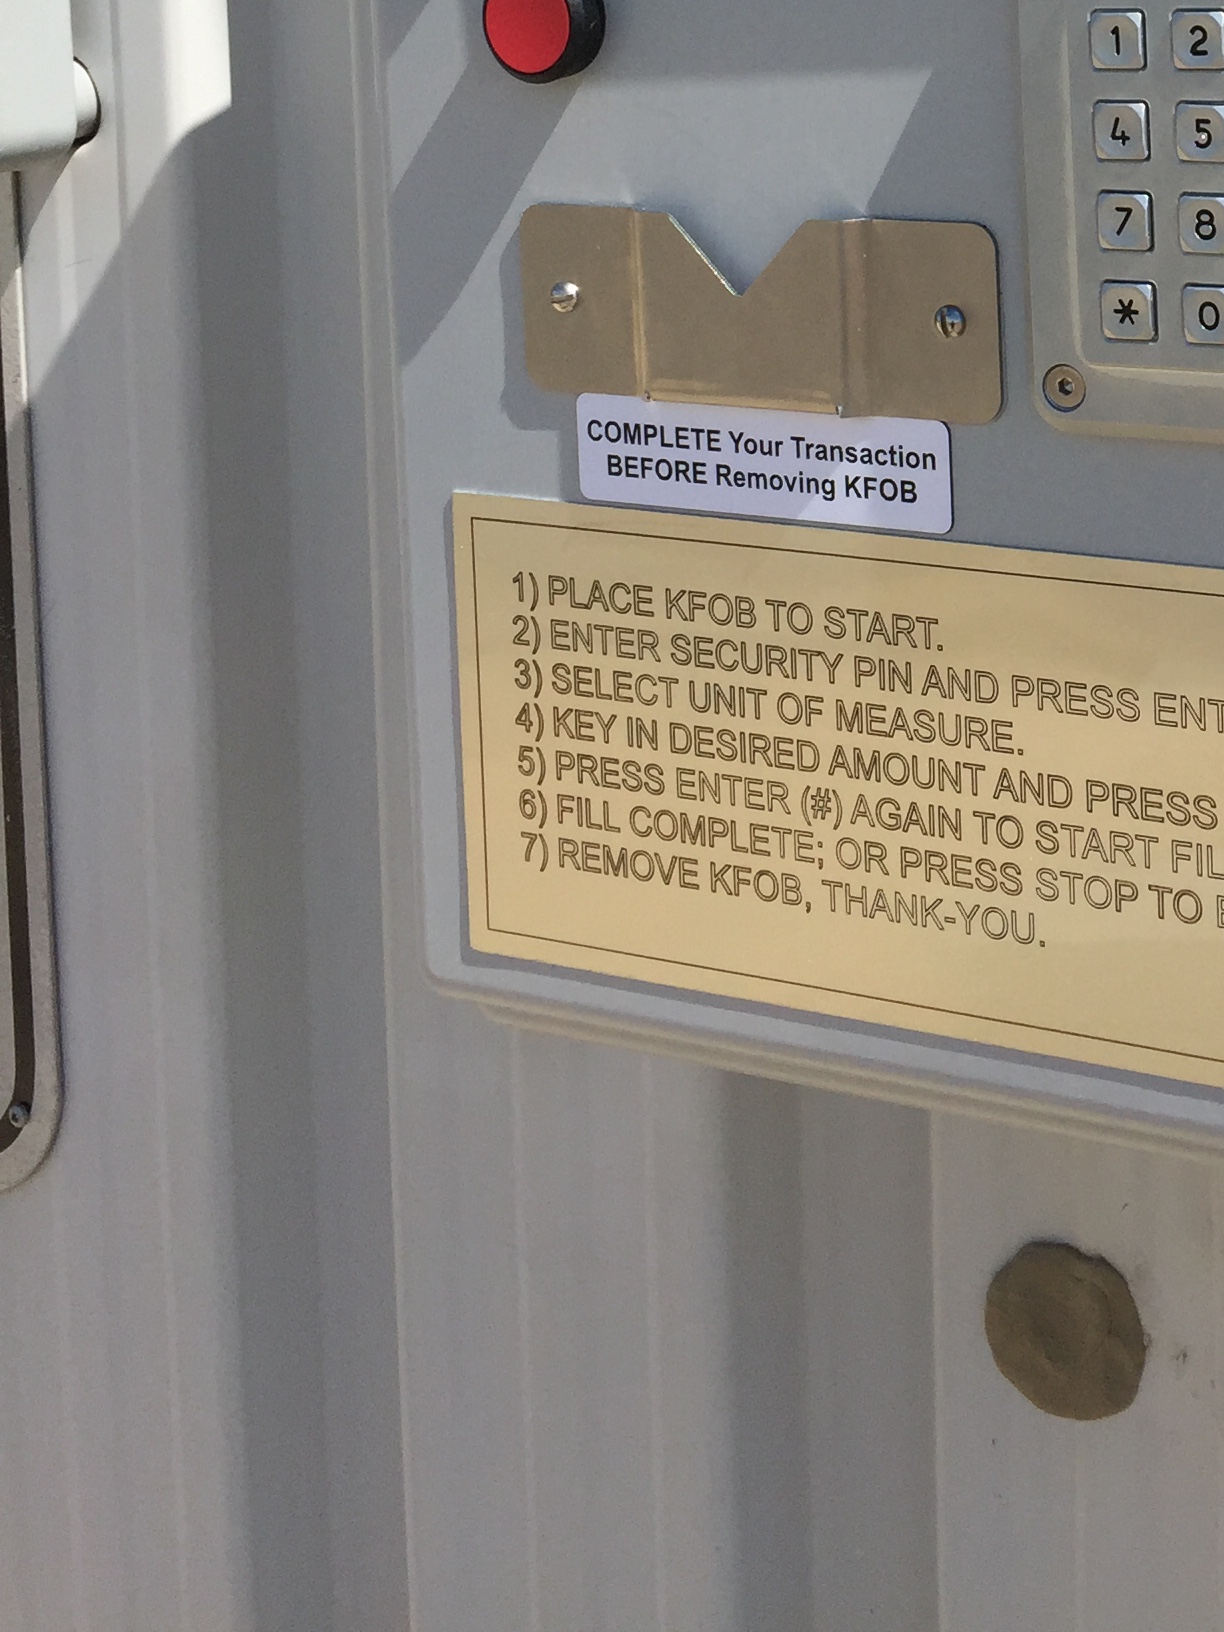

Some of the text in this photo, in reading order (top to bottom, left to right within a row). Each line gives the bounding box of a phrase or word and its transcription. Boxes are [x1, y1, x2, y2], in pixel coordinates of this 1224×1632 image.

[1110, 26, 1121, 55] 1
[1189, 26, 1208, 56] 2
[1111, 117, 1130, 146] 4
[1194, 119, 1212, 149] 5
[1115, 207, 1133, 235] 7
[1194, 209, 1217, 240] 8
[587, 419, 936, 470] COMPLETE Your Transaction
[607, 454, 917, 504] BEFORE Removing KFOB
[512, 571, 943, 652] 1) PLACE KFOB TO START.
[512, 615, 541, 654] 2)
[550, 619, 661, 662] ENTER
[670, 635, 844, 685] SECURITY
[855, 656, 912, 694] PIN
[922, 665, 1000, 705] AND
[1011, 675, 1140, 722] PRESS
[514, 659, 1025, 756] 3) SELECT UNIT OF MEASURE.
[515, 703, 544, 742] 4)
[553, 706, 617, 744] KEY
[627, 716, 658, 751] IN
[670, 723, 820, 774] DESIRED
[829, 744, 986, 797] AMOUNT
[993, 768, 1074, 808] AND
[1085, 779, 1218, 829] PRESS
[518, 745, 546, 786] 5)
[555, 750, 665, 795] PRESS
[676, 768, 792, 815] ENTER
[800, 786, 843, 831] (#)
[851, 795, 963, 841] AGAIN
[973, 809, 1025, 850] TO
[1034, 821, 1158, 870] START
[519, 789, 547, 829] 6)
[556, 794, 621, 833] FILL
[629, 805, 825, 870] COMPLETE;
[836, 836, 889, 874] OR
[900, 848, 1024, 897] PRESS
[1035, 867, 1139, 913] STOP
[1148, 884, 1203, 924] TO
[521, 831, 1046, 949] 7) REMOVE KFOB, THANK-YOU.
